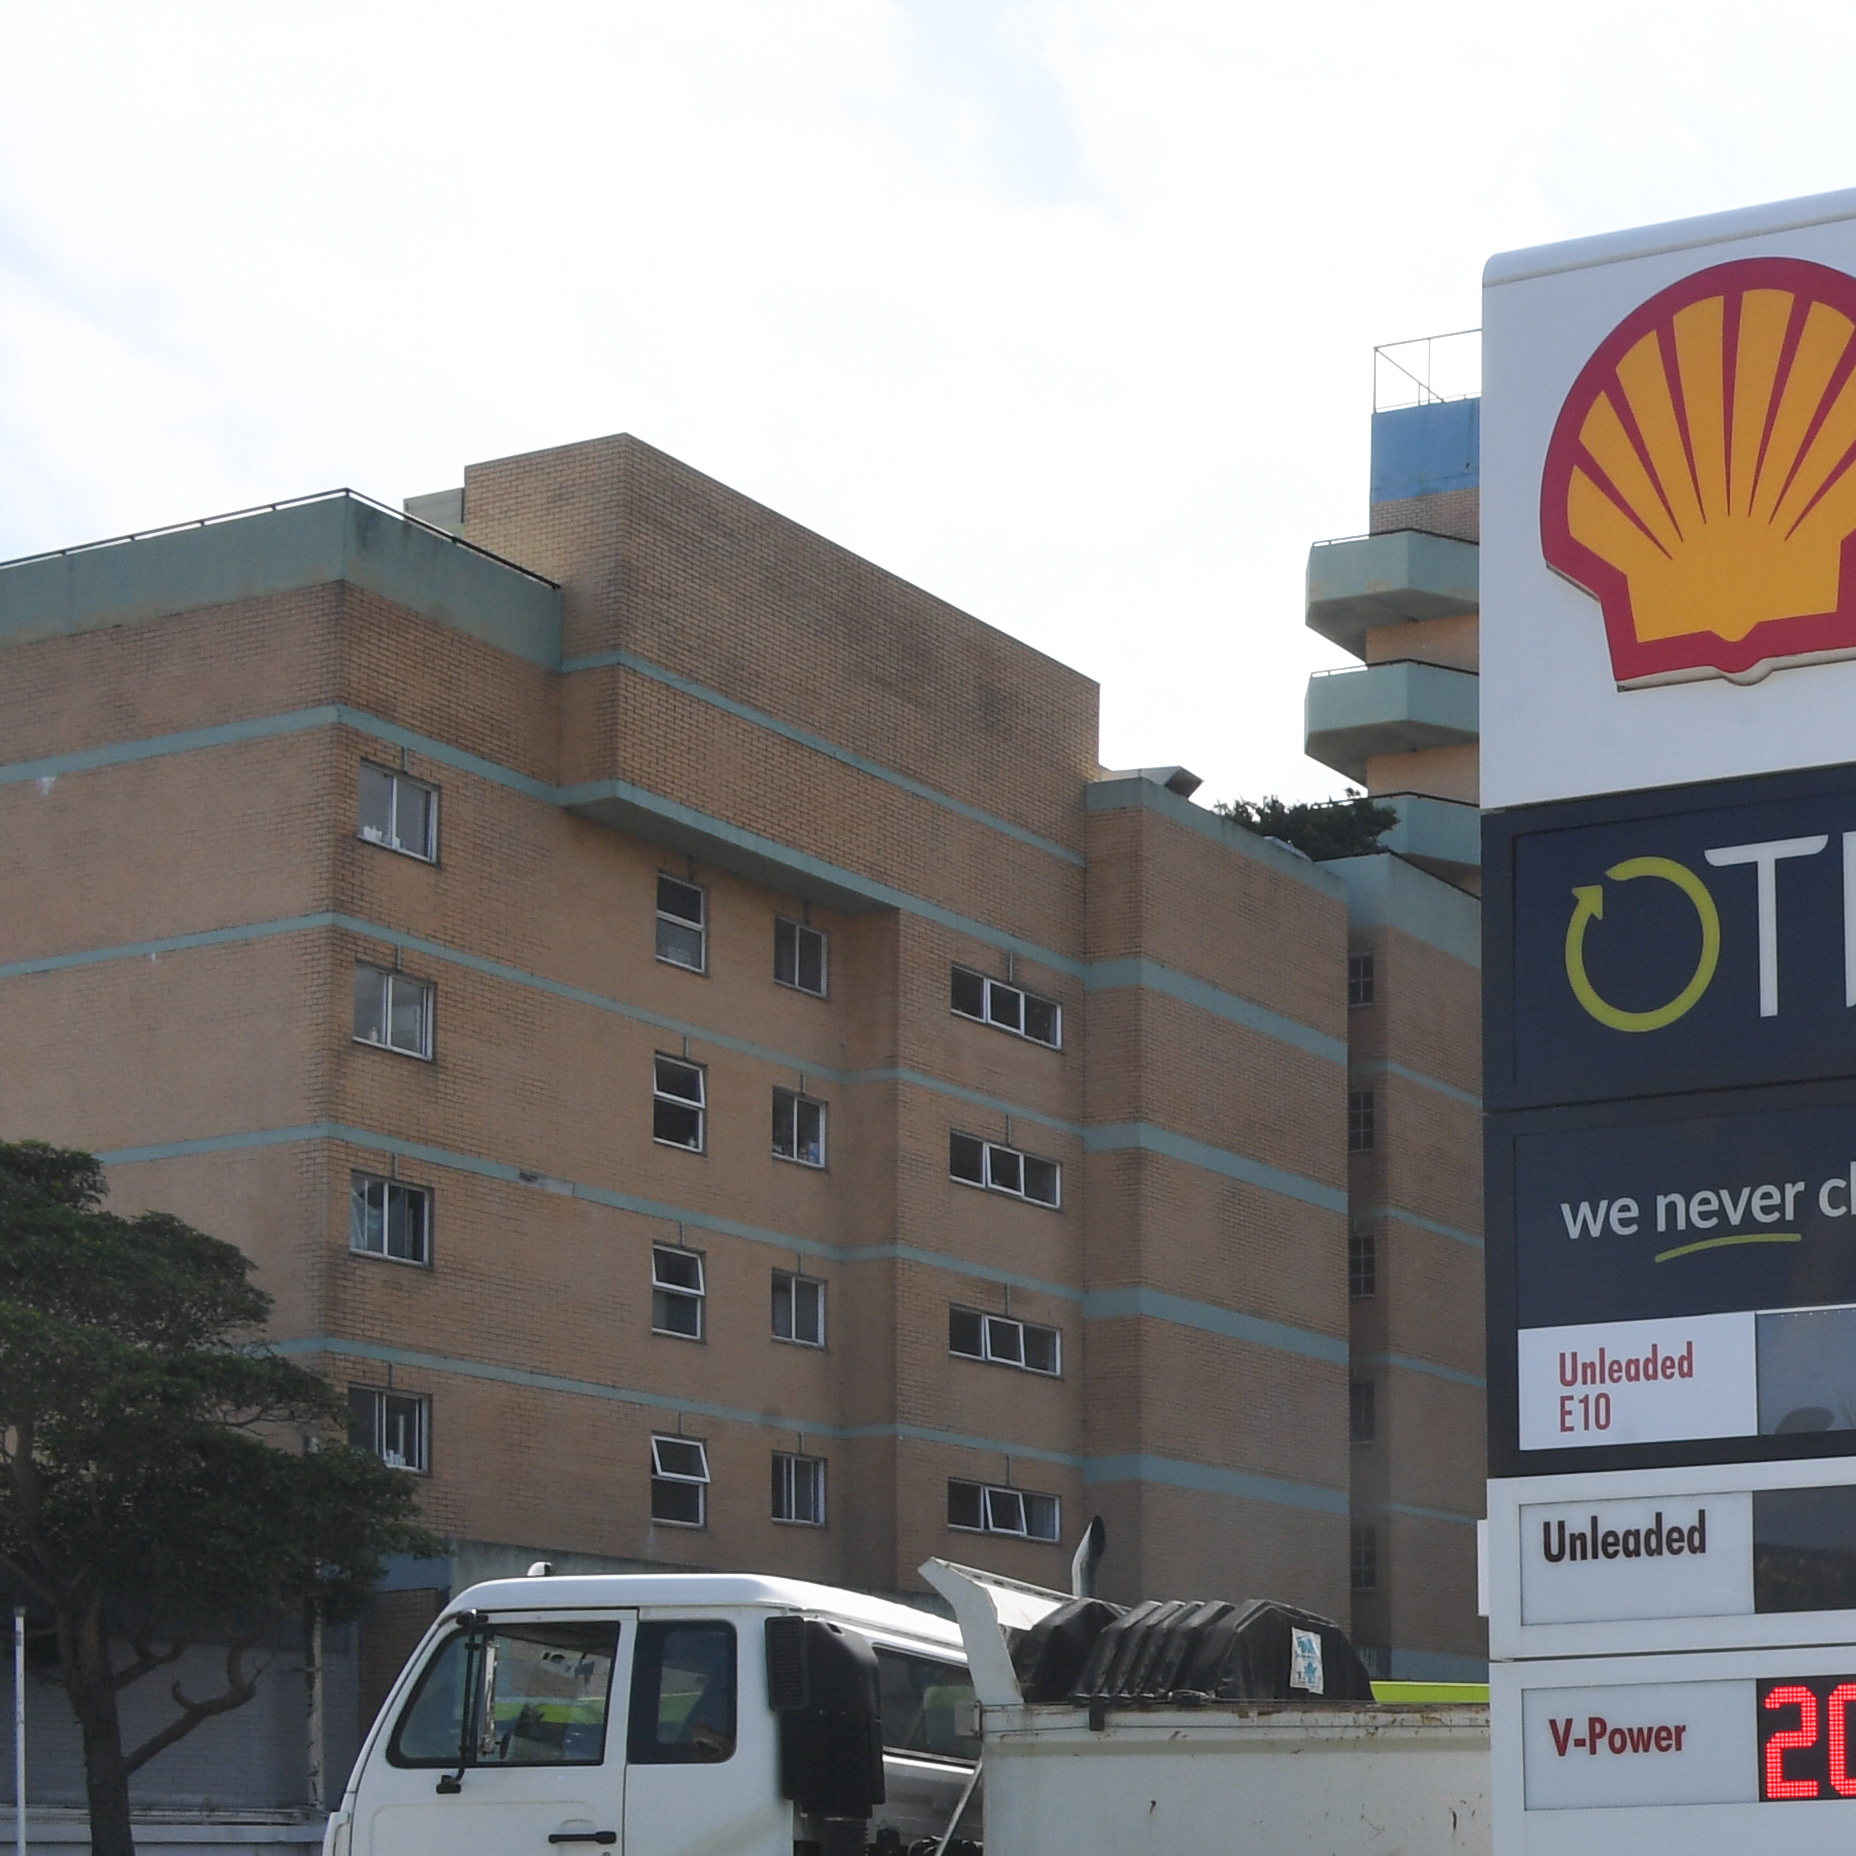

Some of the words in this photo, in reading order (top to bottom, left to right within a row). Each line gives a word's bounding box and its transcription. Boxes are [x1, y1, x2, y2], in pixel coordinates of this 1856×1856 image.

[1560, 1197, 1640, 1240] we
[1656, 1180, 1806, 1233] never
[1559, 1340, 1694, 1387] Unleaded
[1560, 1392, 1611, 1433] E10
[1543, 1508, 1707, 1563] Unleaded
[1548, 1716, 1687, 1758] V-Power
